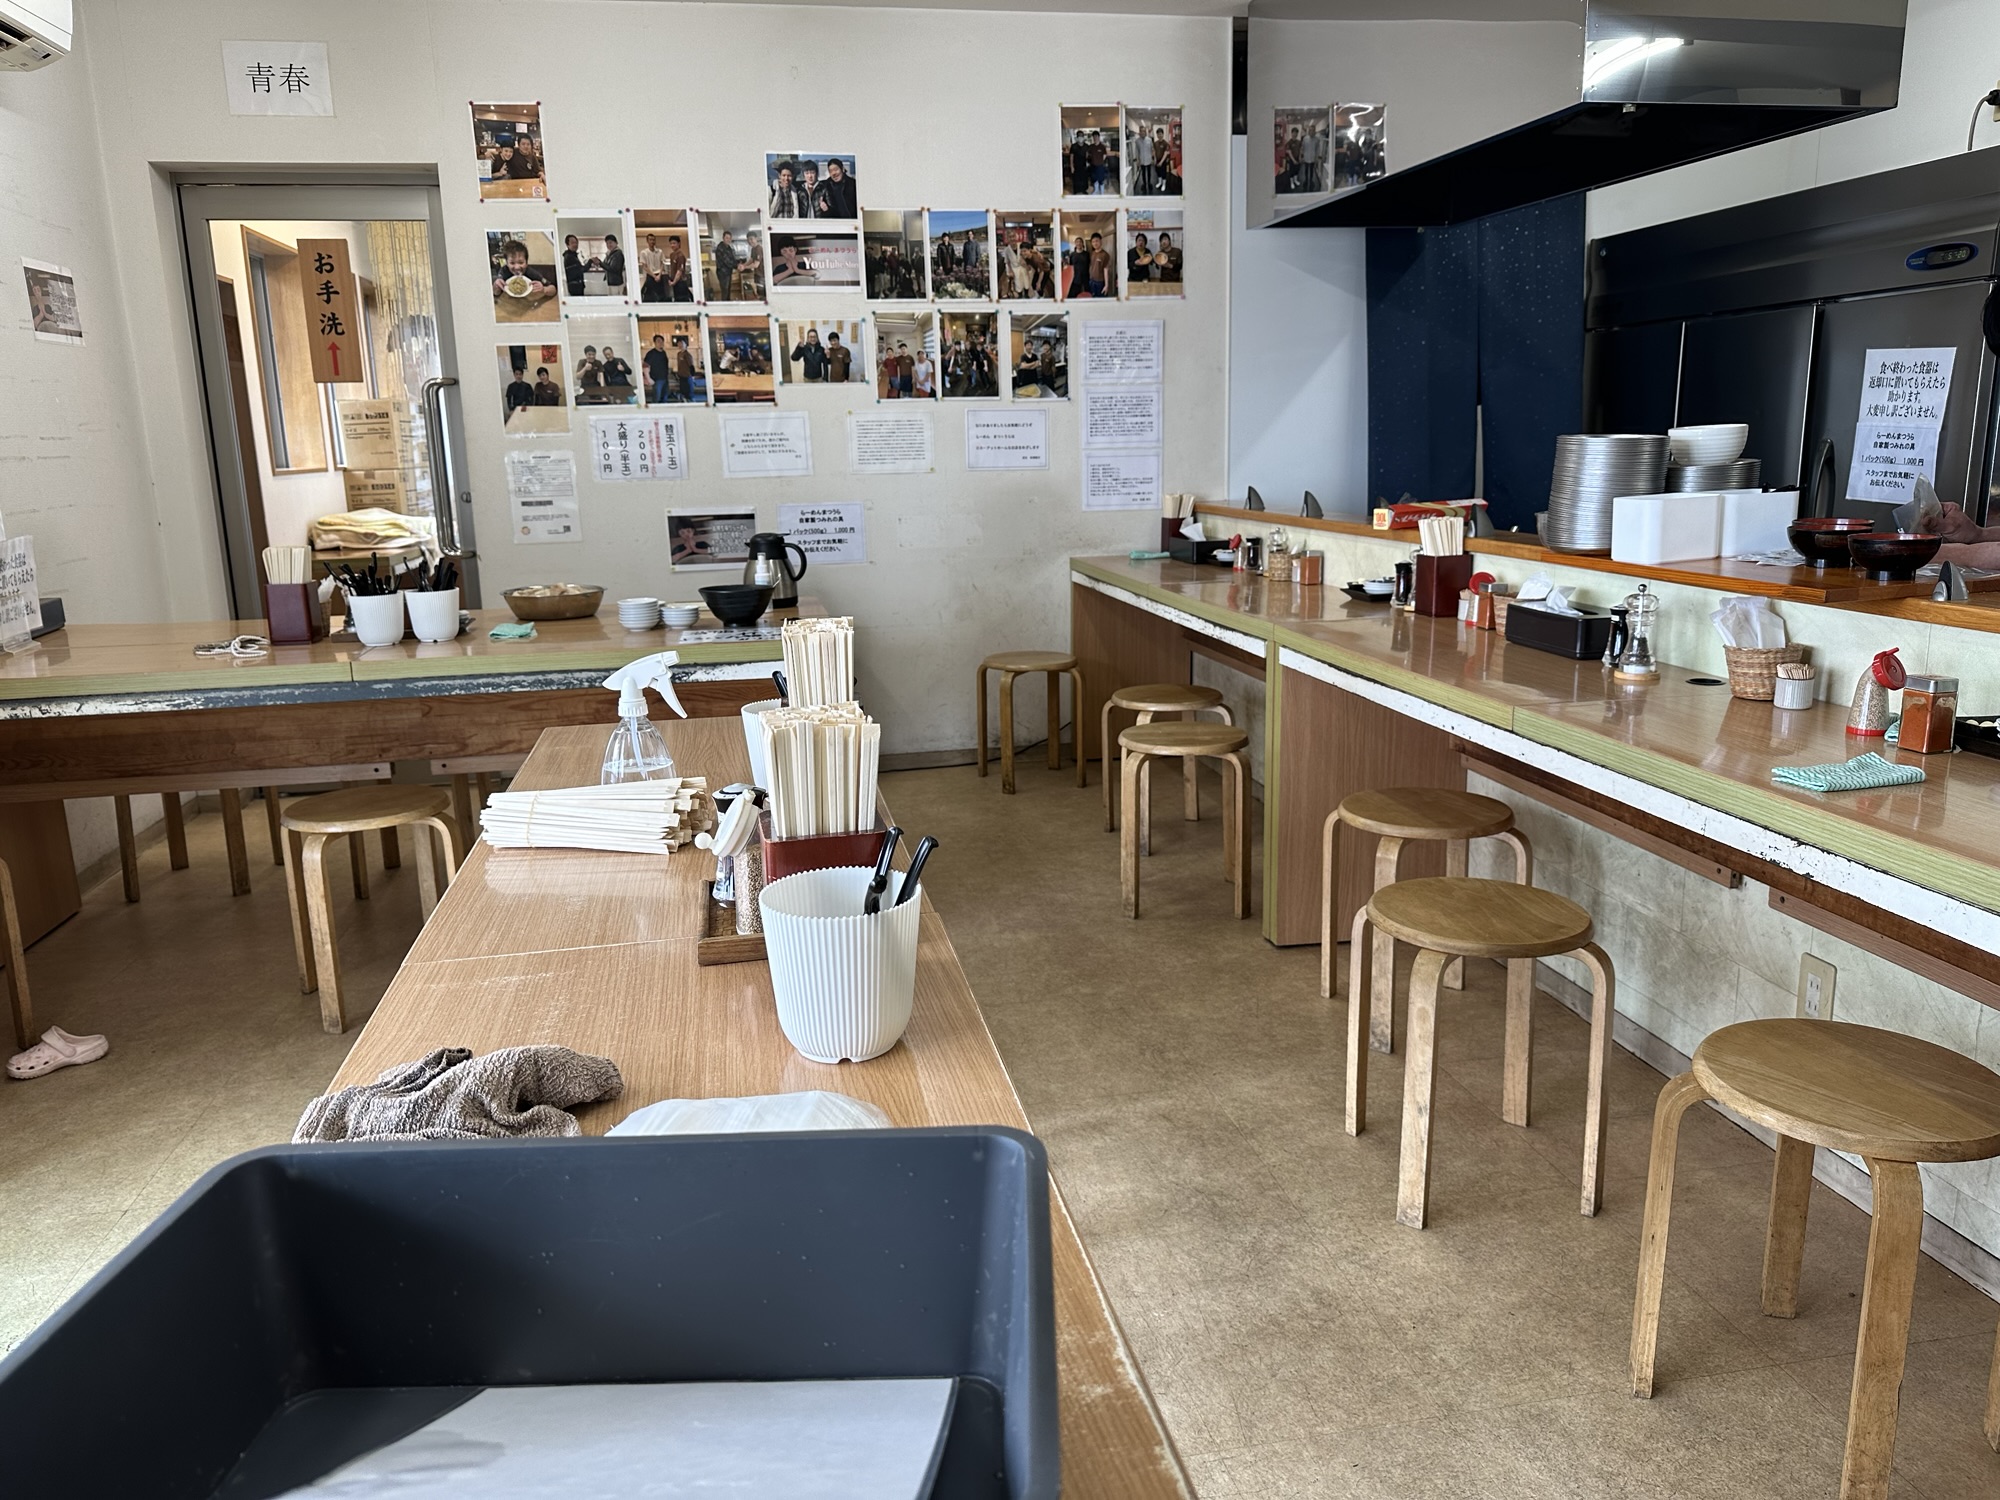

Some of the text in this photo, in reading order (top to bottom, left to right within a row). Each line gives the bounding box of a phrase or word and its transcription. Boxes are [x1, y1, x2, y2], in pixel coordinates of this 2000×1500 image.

[245, 62, 310, 93] 青春
[314, 252, 346, 336] お手洗
[1880, 361, 1940, 375] 食べ終わった食器は
[1868, 375, 1946, 390] 返却口に置いてもらえたら
[1887, 390, 1922, 403] 助かります。
[1866, 404, 1938, 420] 大変申し訳ございません。
[1877, 431, 1915, 441] らーめんまつうら
[602, 430, 613, 473] 100円
[617, 421, 632, 477] 大盛り(半玉)
[638, 430, 650, 473] 200円
[1873, 441, 1915, 451] 自家製つみれの具
[1865, 469, 1915, 479] スタッフまでお気軽に
[1869, 479, 1905, 489] お伝えください。
[800, 508, 842, 516] らーめんまつうら
[799, 516, 844, 524] 自家製つみれの具
[797, 538, 849, 546] スタッフまでお気軽に
